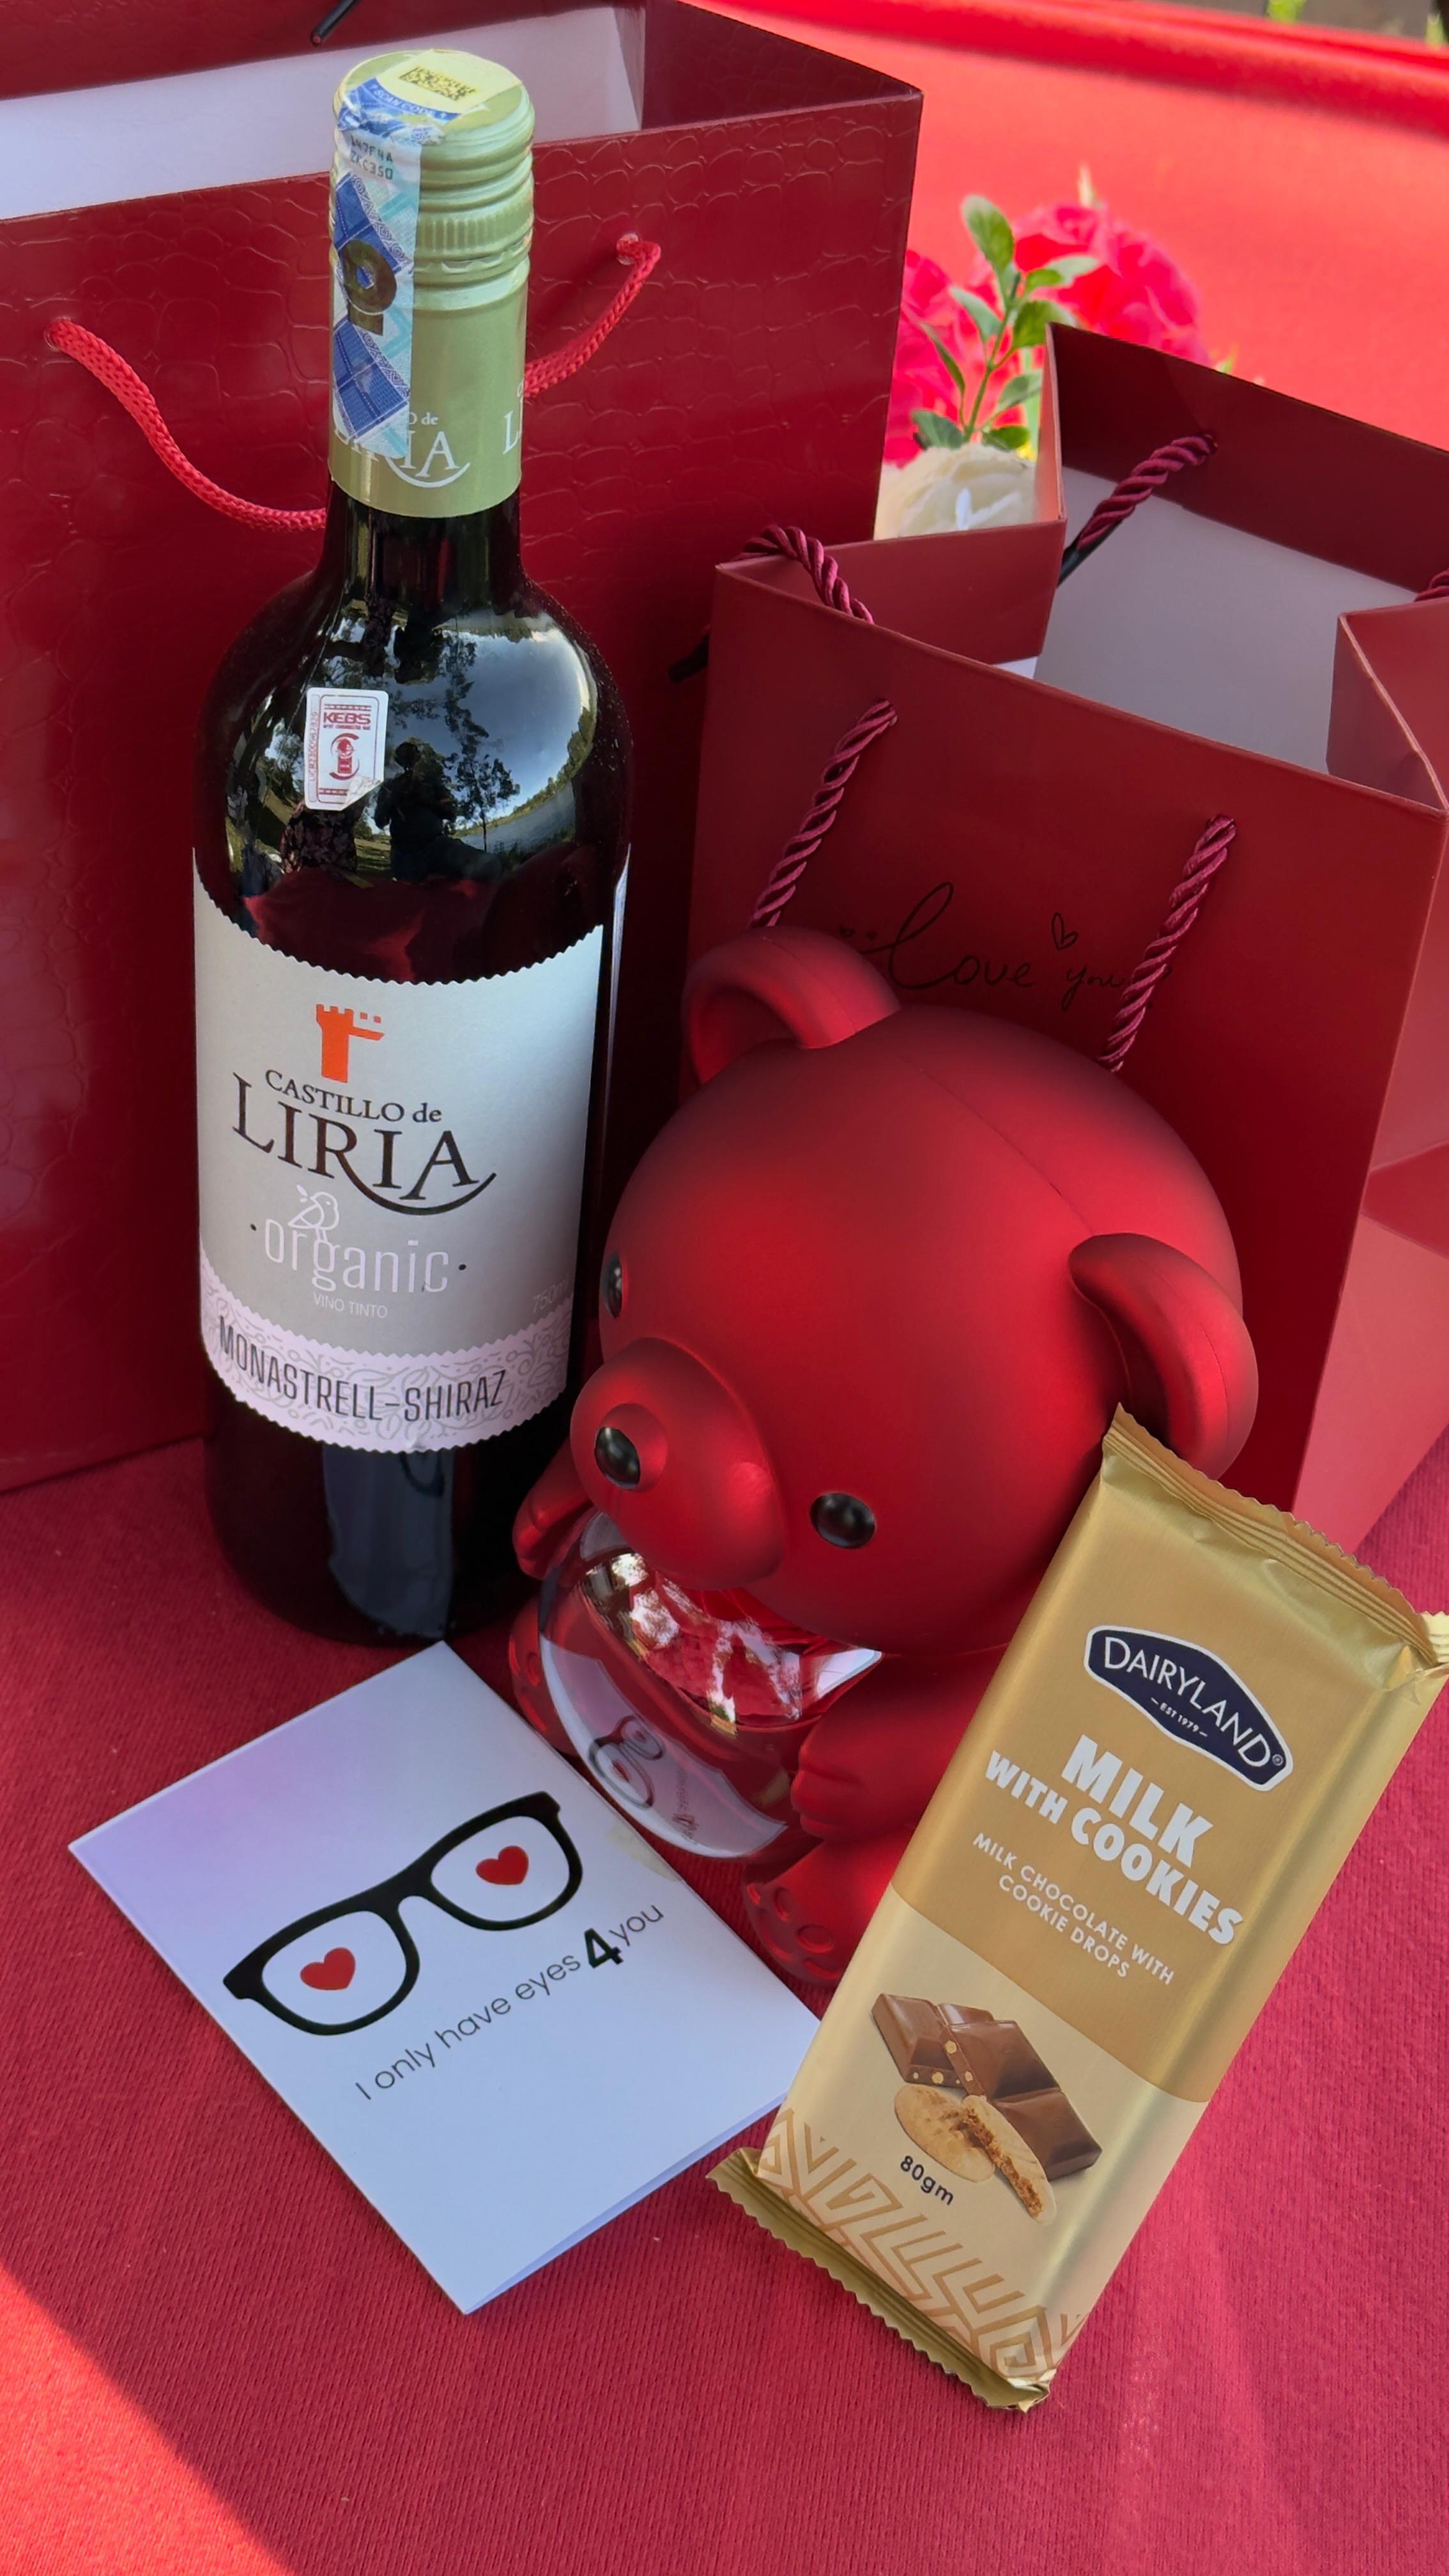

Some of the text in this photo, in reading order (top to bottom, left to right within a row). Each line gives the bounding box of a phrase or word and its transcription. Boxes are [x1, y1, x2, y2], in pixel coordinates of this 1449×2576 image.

[323, 712, 371, 725] KEBS
[265, 1069, 442, 1123] CASTILLO de
[233, 1072, 496, 1215] LIRIA
[264, 1218, 448, 1292] organic
[313, 1292, 388, 1319] VINO TINTO
[1160, 1701, 1200, 1733] EST 1979
[1061, 1734, 1213, 1867] MILK
[985, 1750, 1243, 1945] WITH COOKIES
[973, 1833, 1174, 1985] MILK CHOCOLATE WITH
[999, 1874, 1130, 1978] COOKIE DROPS
[374, 2043, 436, 2089] only
[434, 1997, 510, 2048] have
[514, 1954, 581, 2000] eyes
[583, 1928, 624, 1968] 4
[609, 1905, 664, 1946] you
[899, 2155, 954, 2205] 80gm
